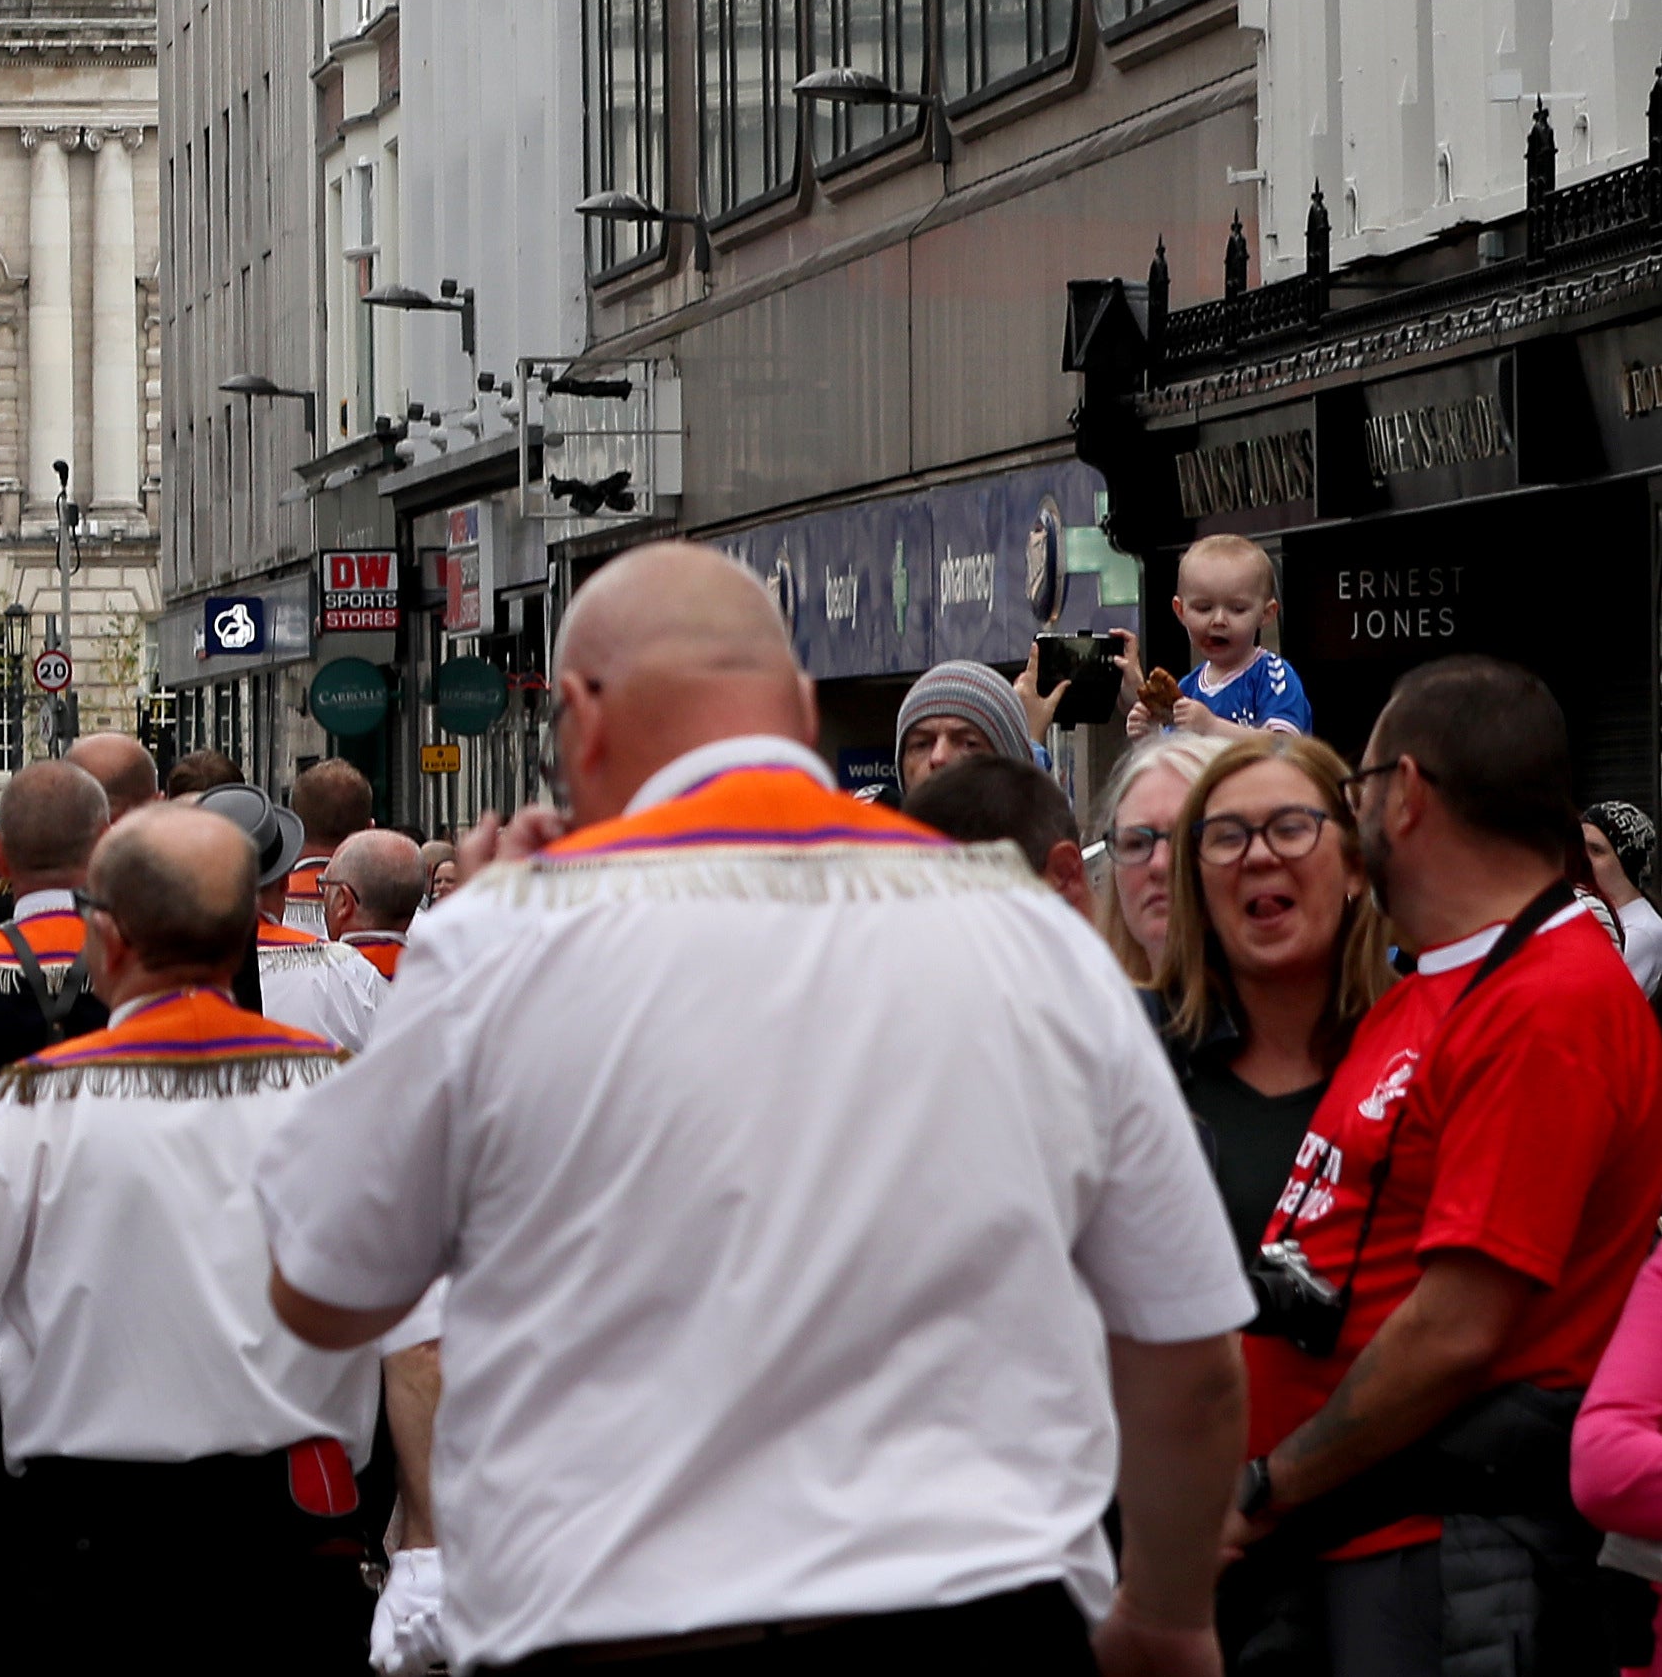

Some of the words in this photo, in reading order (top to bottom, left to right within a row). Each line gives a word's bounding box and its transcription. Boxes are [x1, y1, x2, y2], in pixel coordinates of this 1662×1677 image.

[330, 555, 391, 590] DW
[940, 544, 995, 617] pharmacy
[1338, 566, 1465, 601] ERNEST
[325, 592, 397, 609] SPORTS
[826, 563, 858, 630] beauty
[327, 610, 397, 627] STORES
[1350, 606, 1457, 640] JONES
[39, 662, 67, 680] 20
